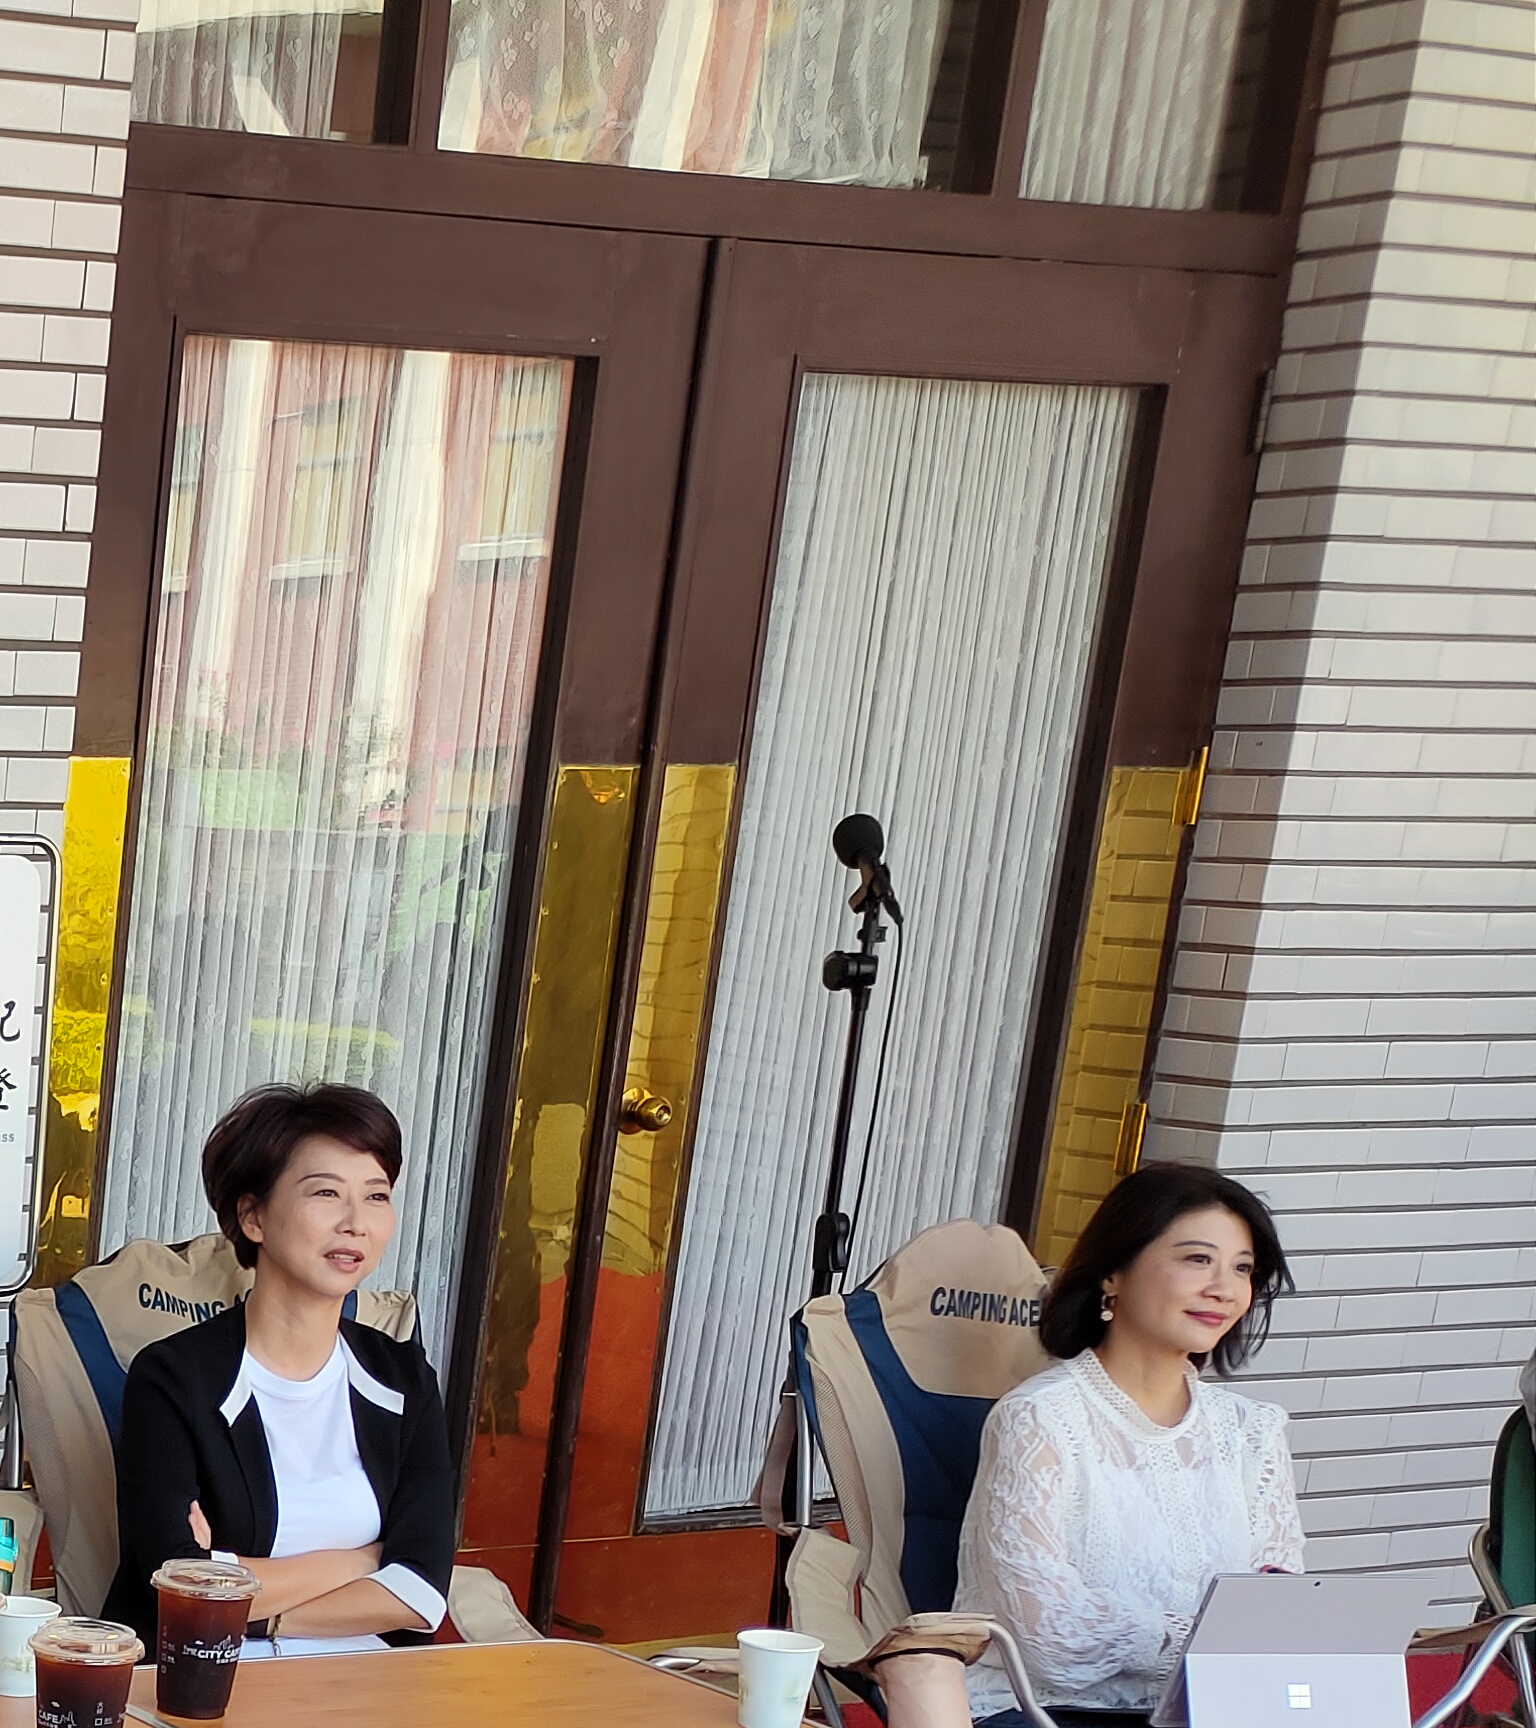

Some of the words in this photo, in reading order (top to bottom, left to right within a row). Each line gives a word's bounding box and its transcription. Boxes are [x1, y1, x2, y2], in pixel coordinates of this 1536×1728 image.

[930, 1287, 1007, 1325] CAMPING
[1008, 1297, 1040, 1327] ACE
[197, 1649, 224, 1660] CITY
